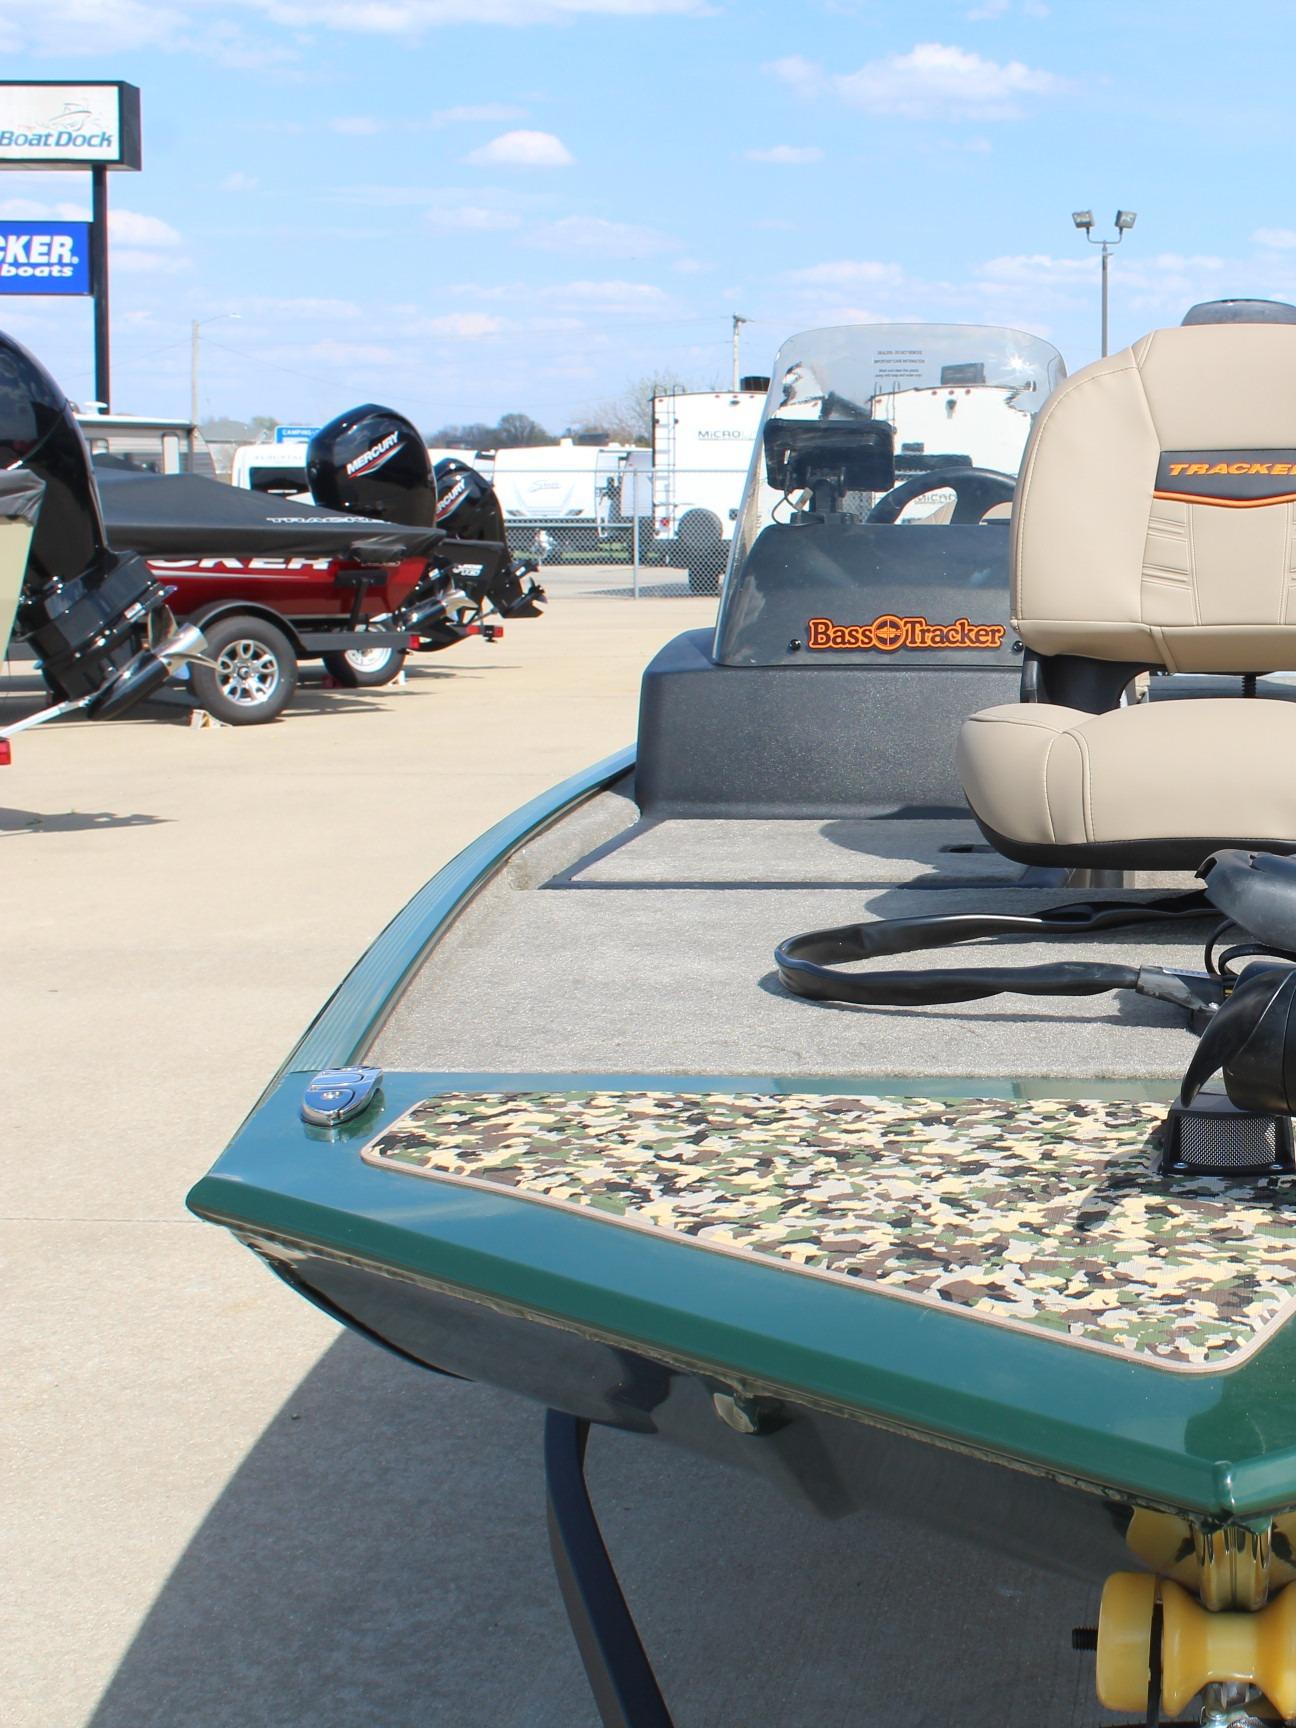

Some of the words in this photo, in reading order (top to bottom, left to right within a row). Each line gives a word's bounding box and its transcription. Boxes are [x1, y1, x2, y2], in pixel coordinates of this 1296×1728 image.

[0, 130, 54, 147] Boat
[54, 131, 113, 148] Dock
[0, 263, 74, 277] boats
[346, 430, 399, 474] MERCURY
[811, 620, 873, 647] Bass
[903, 619, 1003, 647] Tracker
